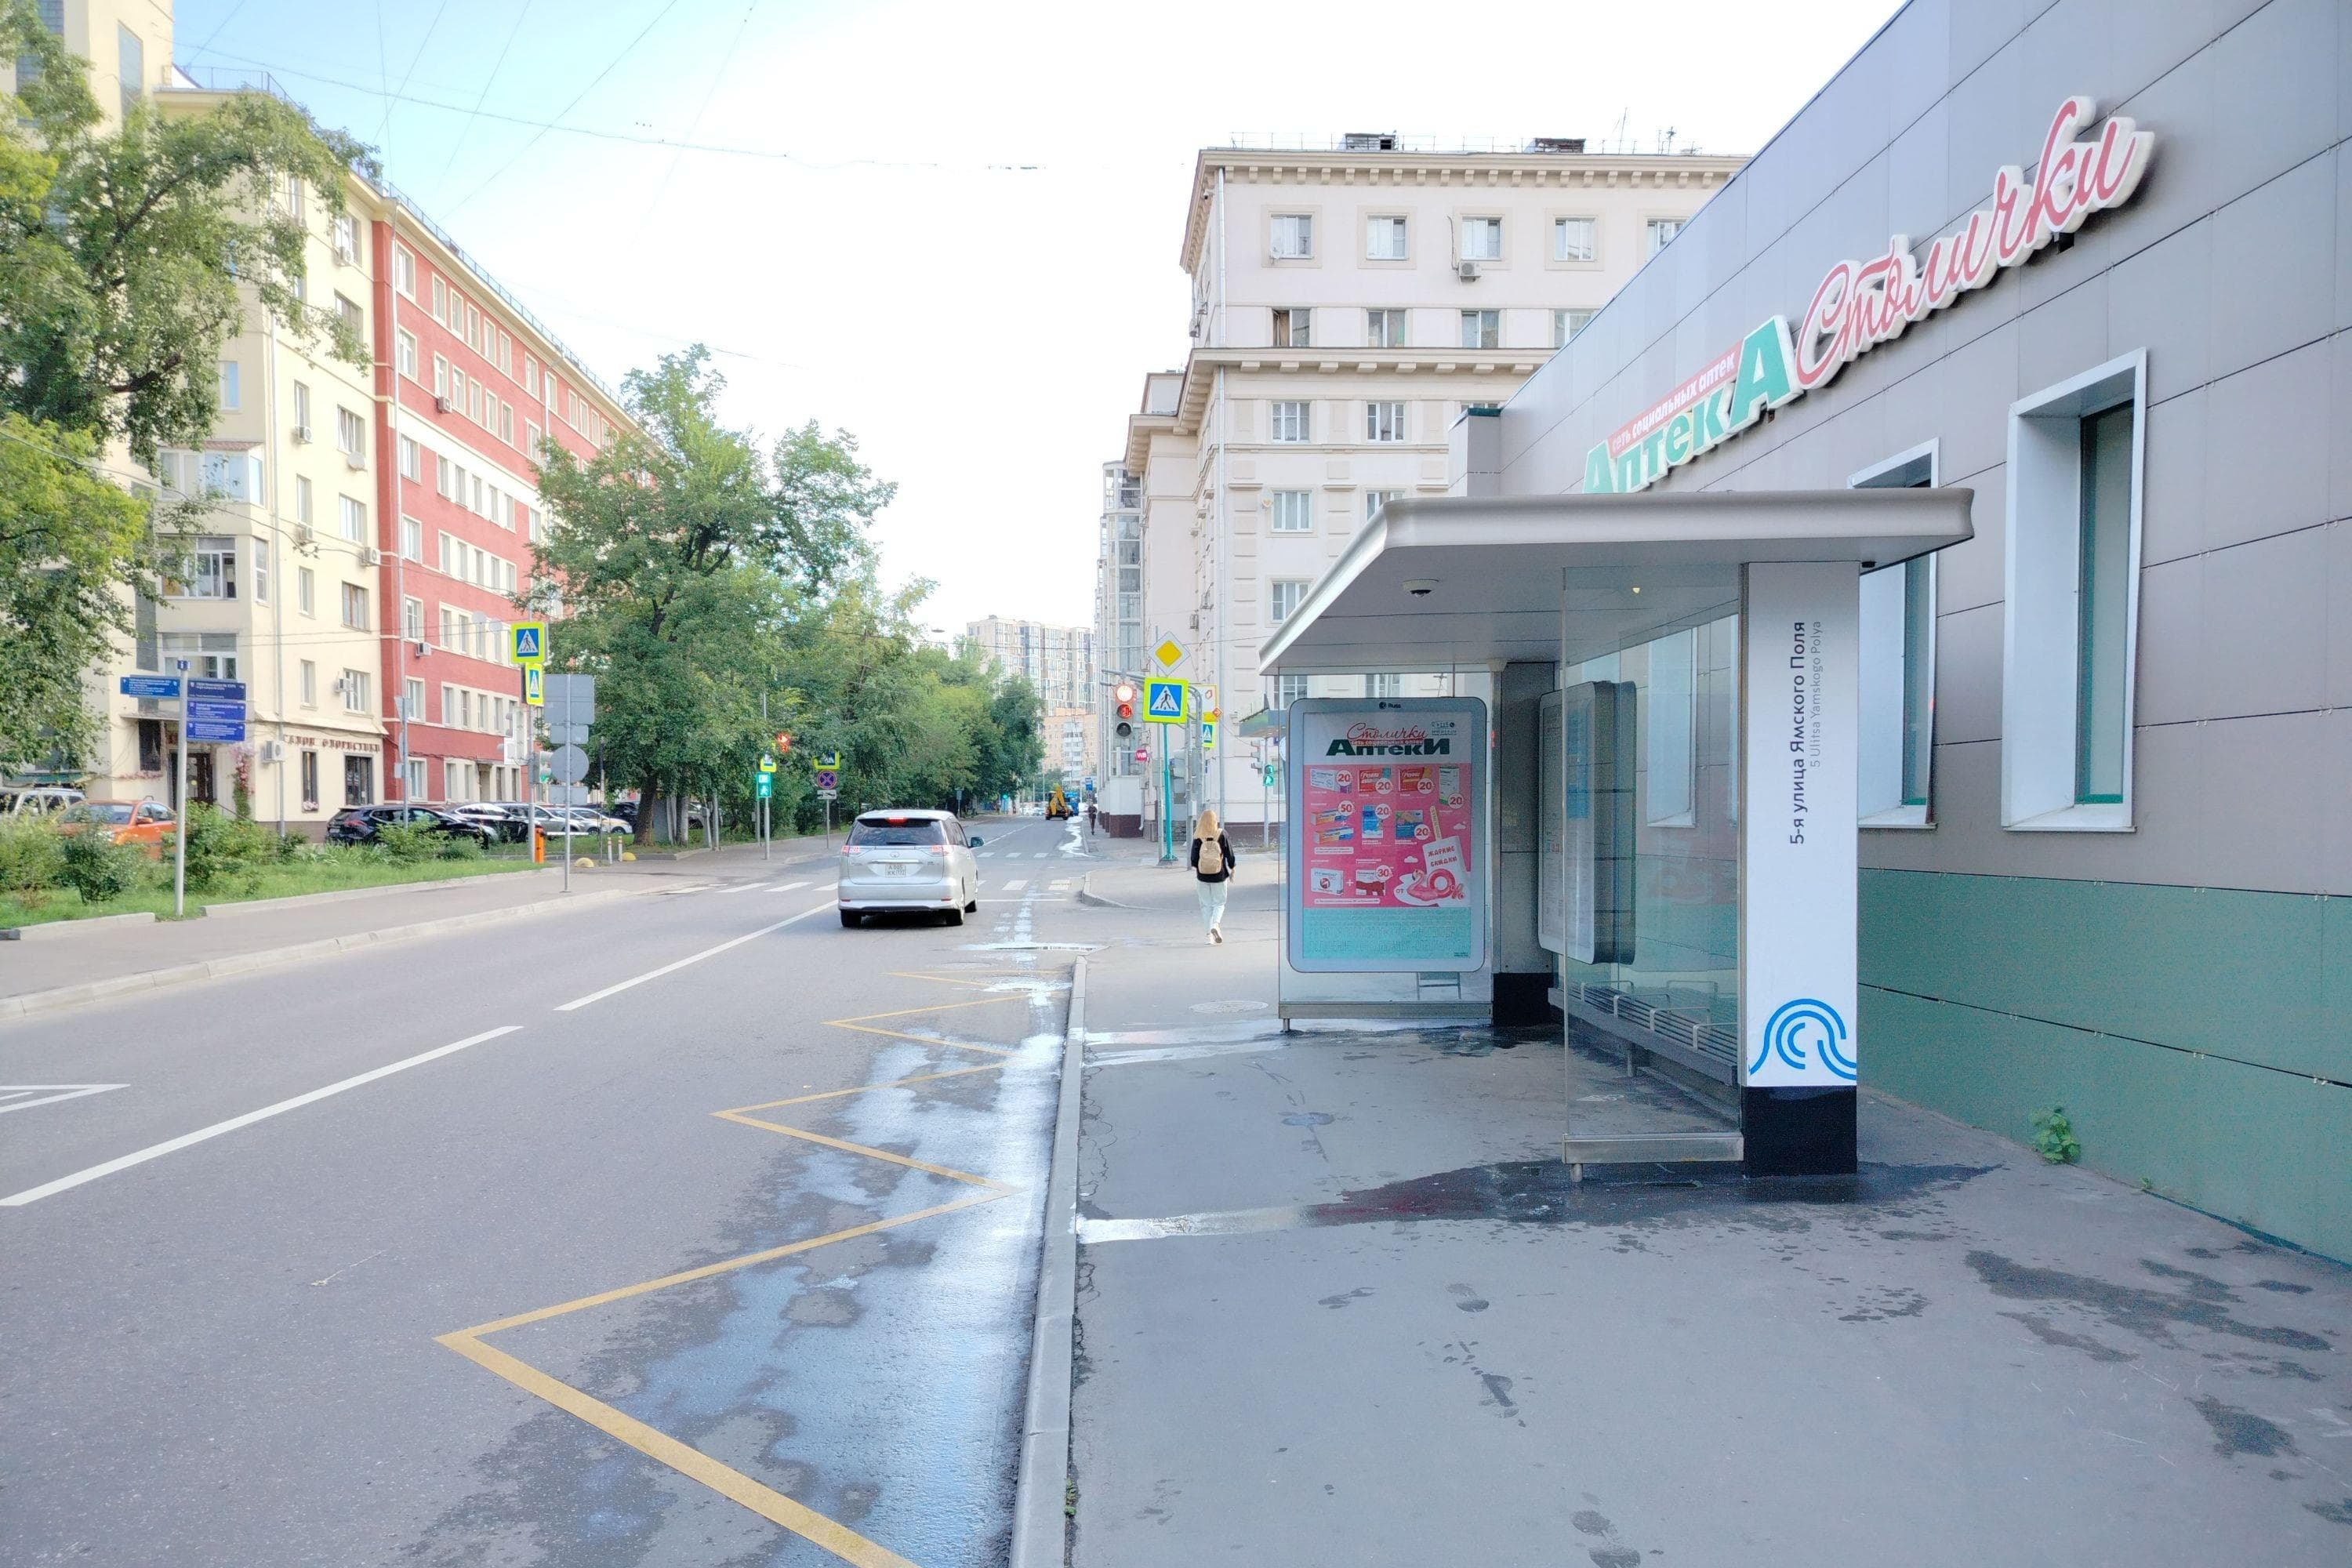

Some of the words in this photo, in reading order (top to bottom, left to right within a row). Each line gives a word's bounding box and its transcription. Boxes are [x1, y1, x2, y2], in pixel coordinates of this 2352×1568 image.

[1796, 100, 2136, 385] Столички
[1612, 432, 1632, 452] сеть
[1632, 381, 1697, 439] социальных
[1698, 352, 1736, 393] аптек
[1790, 622, 1805, 669] Поля
[1809, 621, 1824, 654] Polya
[1790, 674, 1805, 753] Ямского
[1809, 657, 1824, 719] Yamskogo
[1347, 722, 1429, 739] Столички
[1809, 721, 1820, 757] Ulitsa
[1793, 758, 1808, 813] улица
[1790, 818, 1804, 844] 5-я
